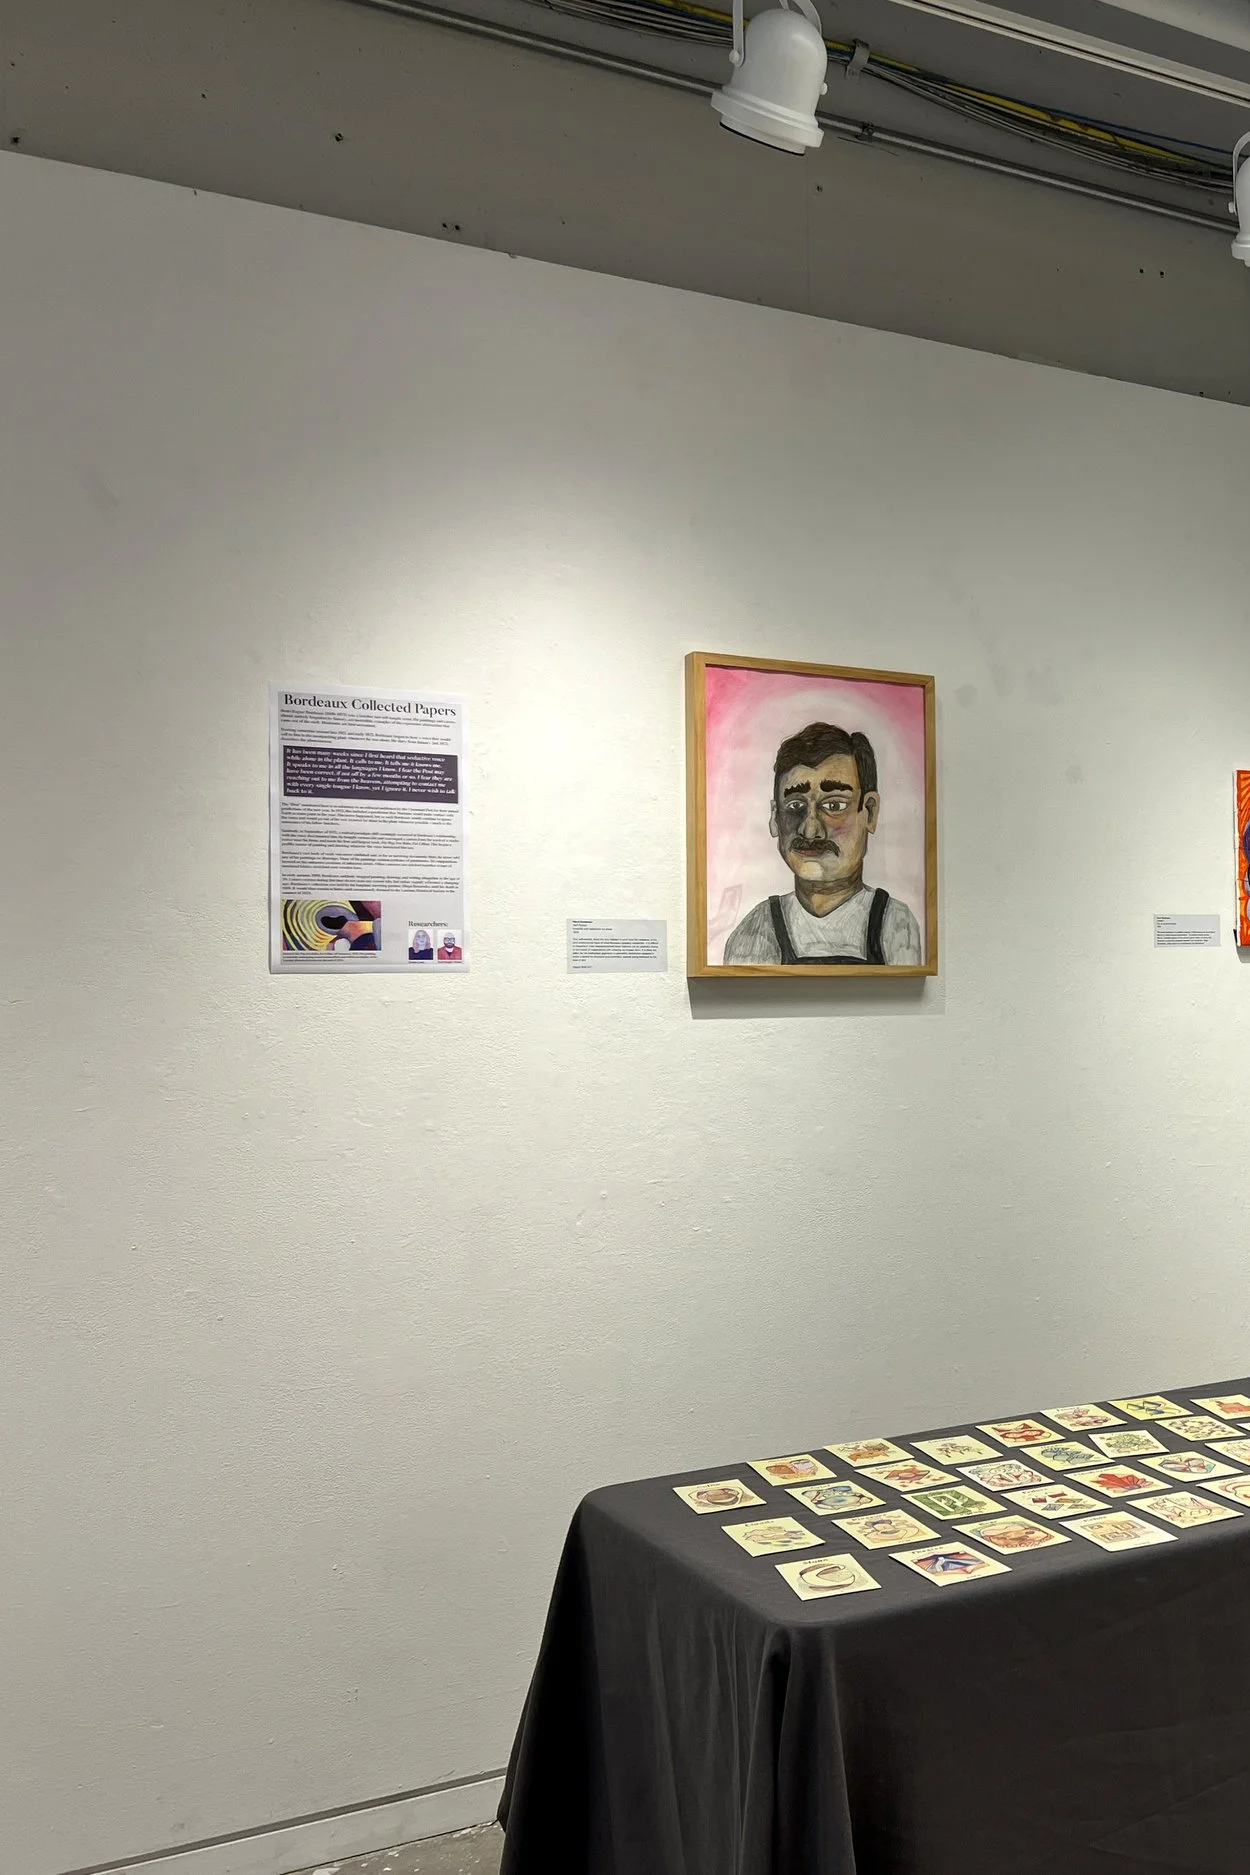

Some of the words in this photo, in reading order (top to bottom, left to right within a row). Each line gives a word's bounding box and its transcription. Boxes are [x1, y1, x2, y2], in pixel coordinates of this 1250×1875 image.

[284, 694, 347, 709] Bordeaux
[352, 699, 410, 713] Collected
[415, 703, 456, 718] Papers
